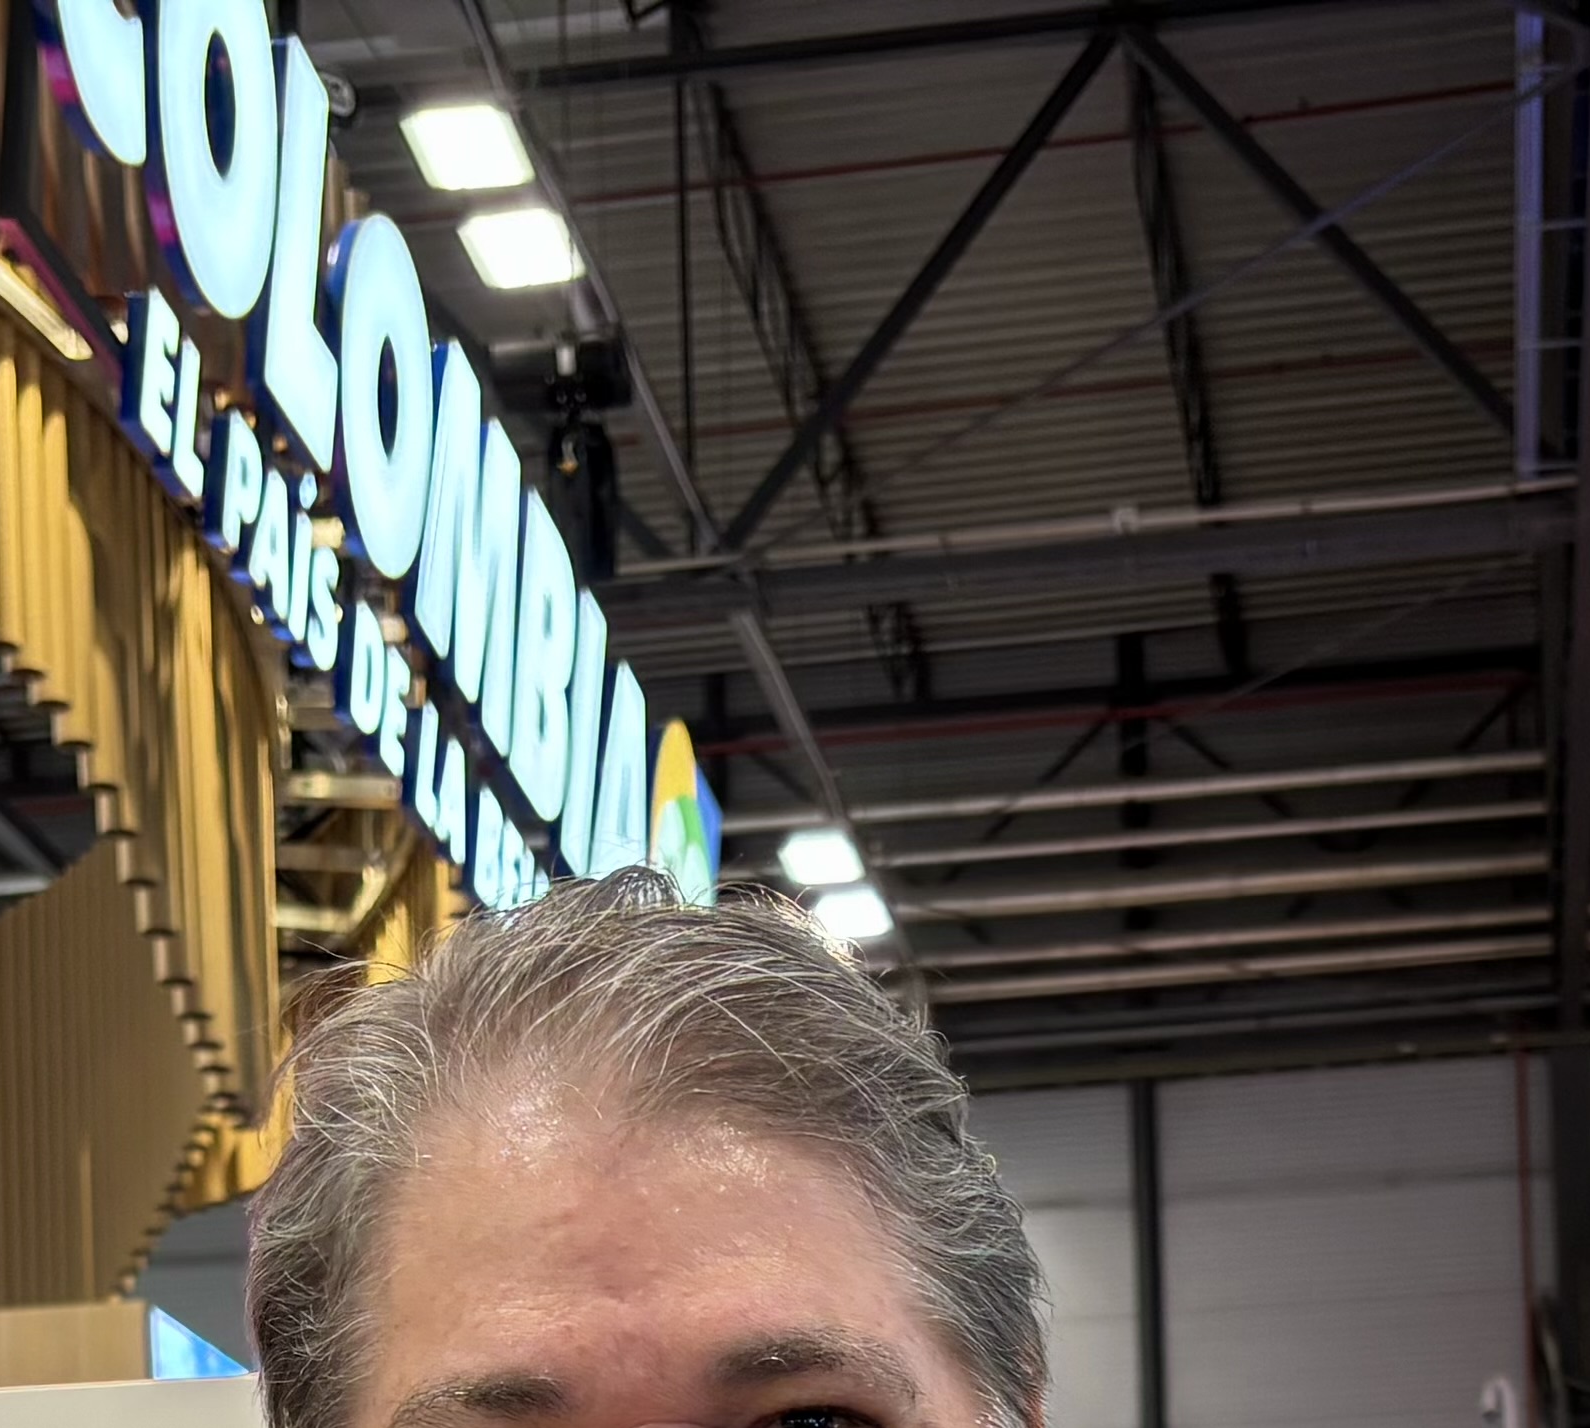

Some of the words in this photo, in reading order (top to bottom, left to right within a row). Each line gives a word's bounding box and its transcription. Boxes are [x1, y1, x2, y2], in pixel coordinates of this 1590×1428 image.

[139, 285, 205, 498] EL
[349, 599, 408, 777] DE
[415, 700, 466, 865] LA
[473, 785, 550, 911] BE
